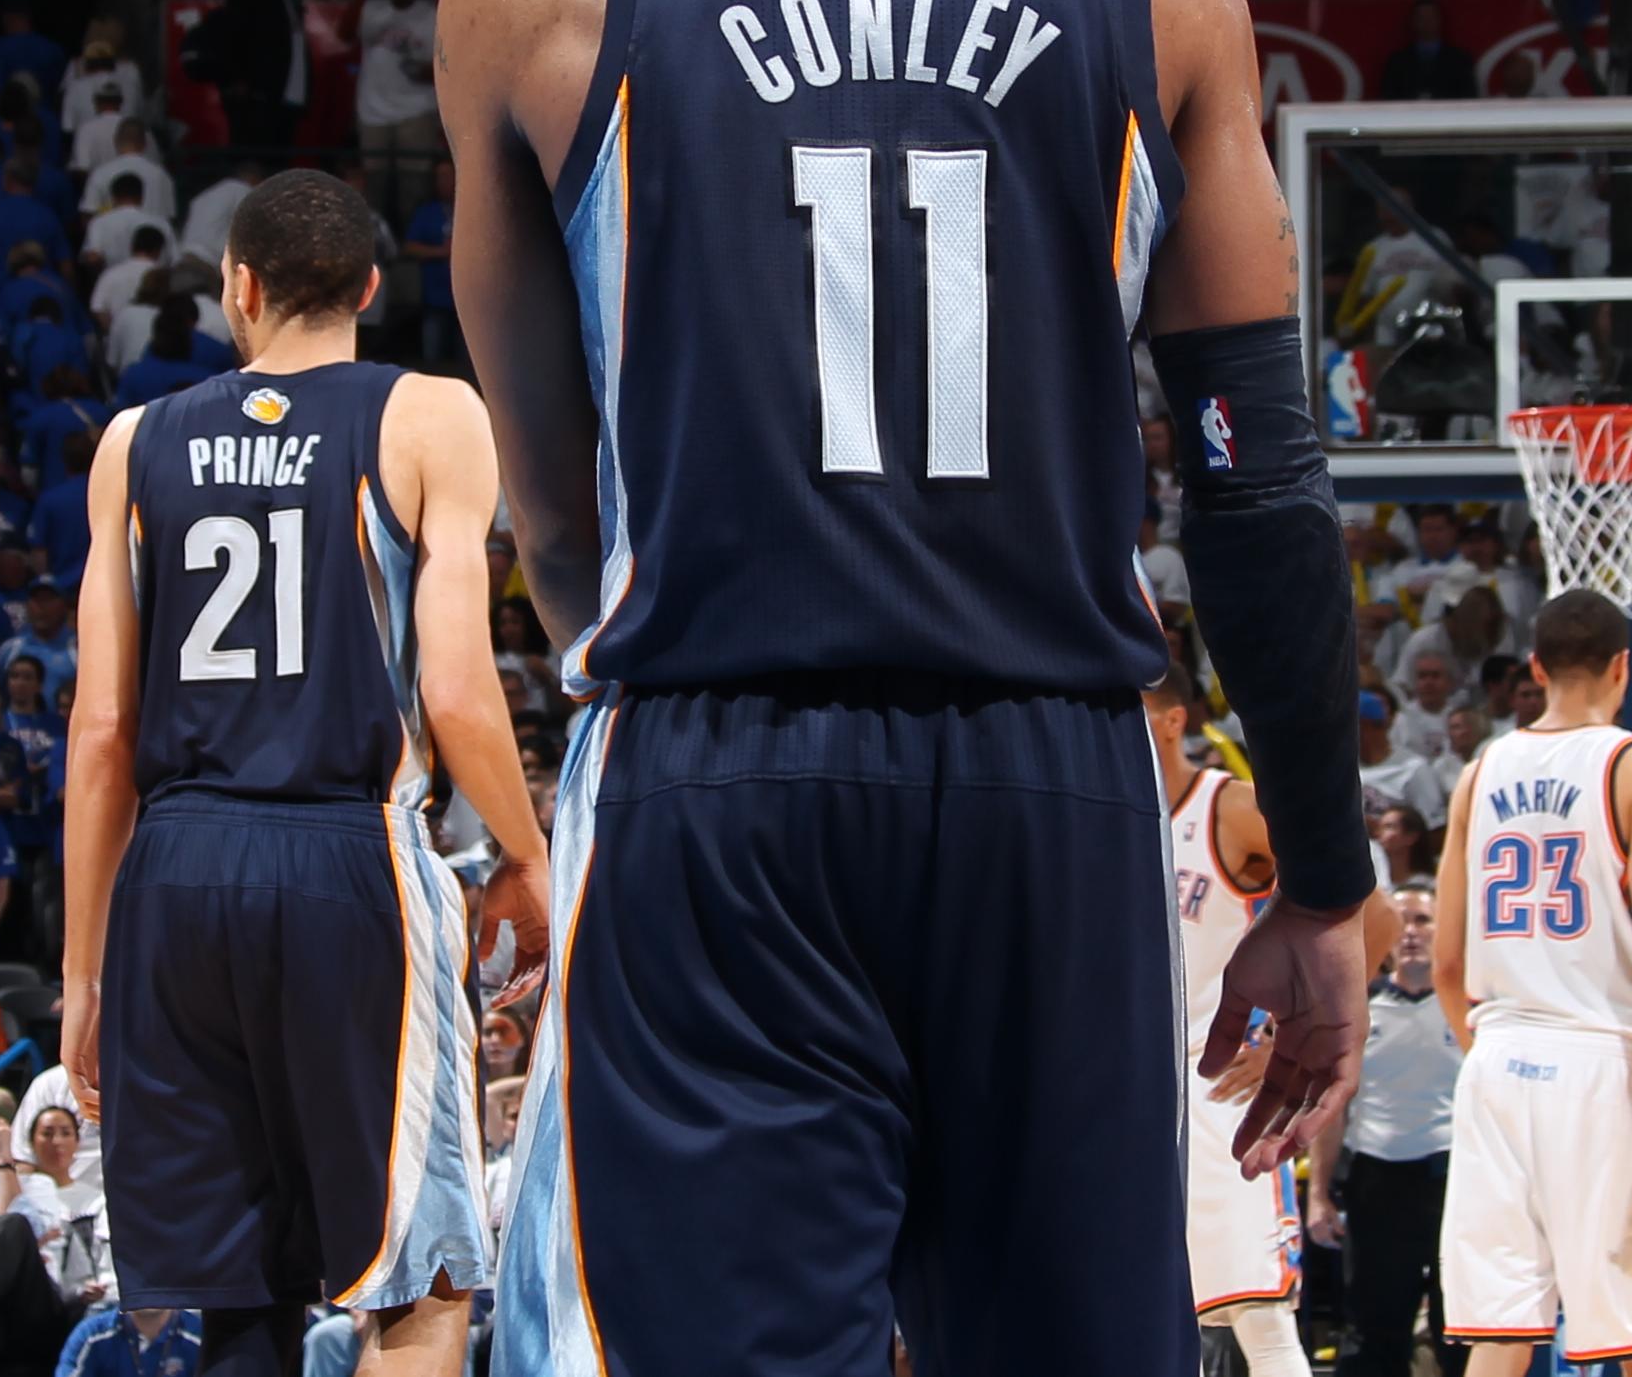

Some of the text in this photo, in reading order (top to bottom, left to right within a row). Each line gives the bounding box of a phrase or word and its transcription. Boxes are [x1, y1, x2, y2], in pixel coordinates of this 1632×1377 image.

[791, 145, 990, 479] 11
[188, 433, 321, 487] PRINCE
[179, 508, 304, 682] 21
[1489, 778, 1582, 824] MARTIN
[1482, 830, 1593, 942] 23
